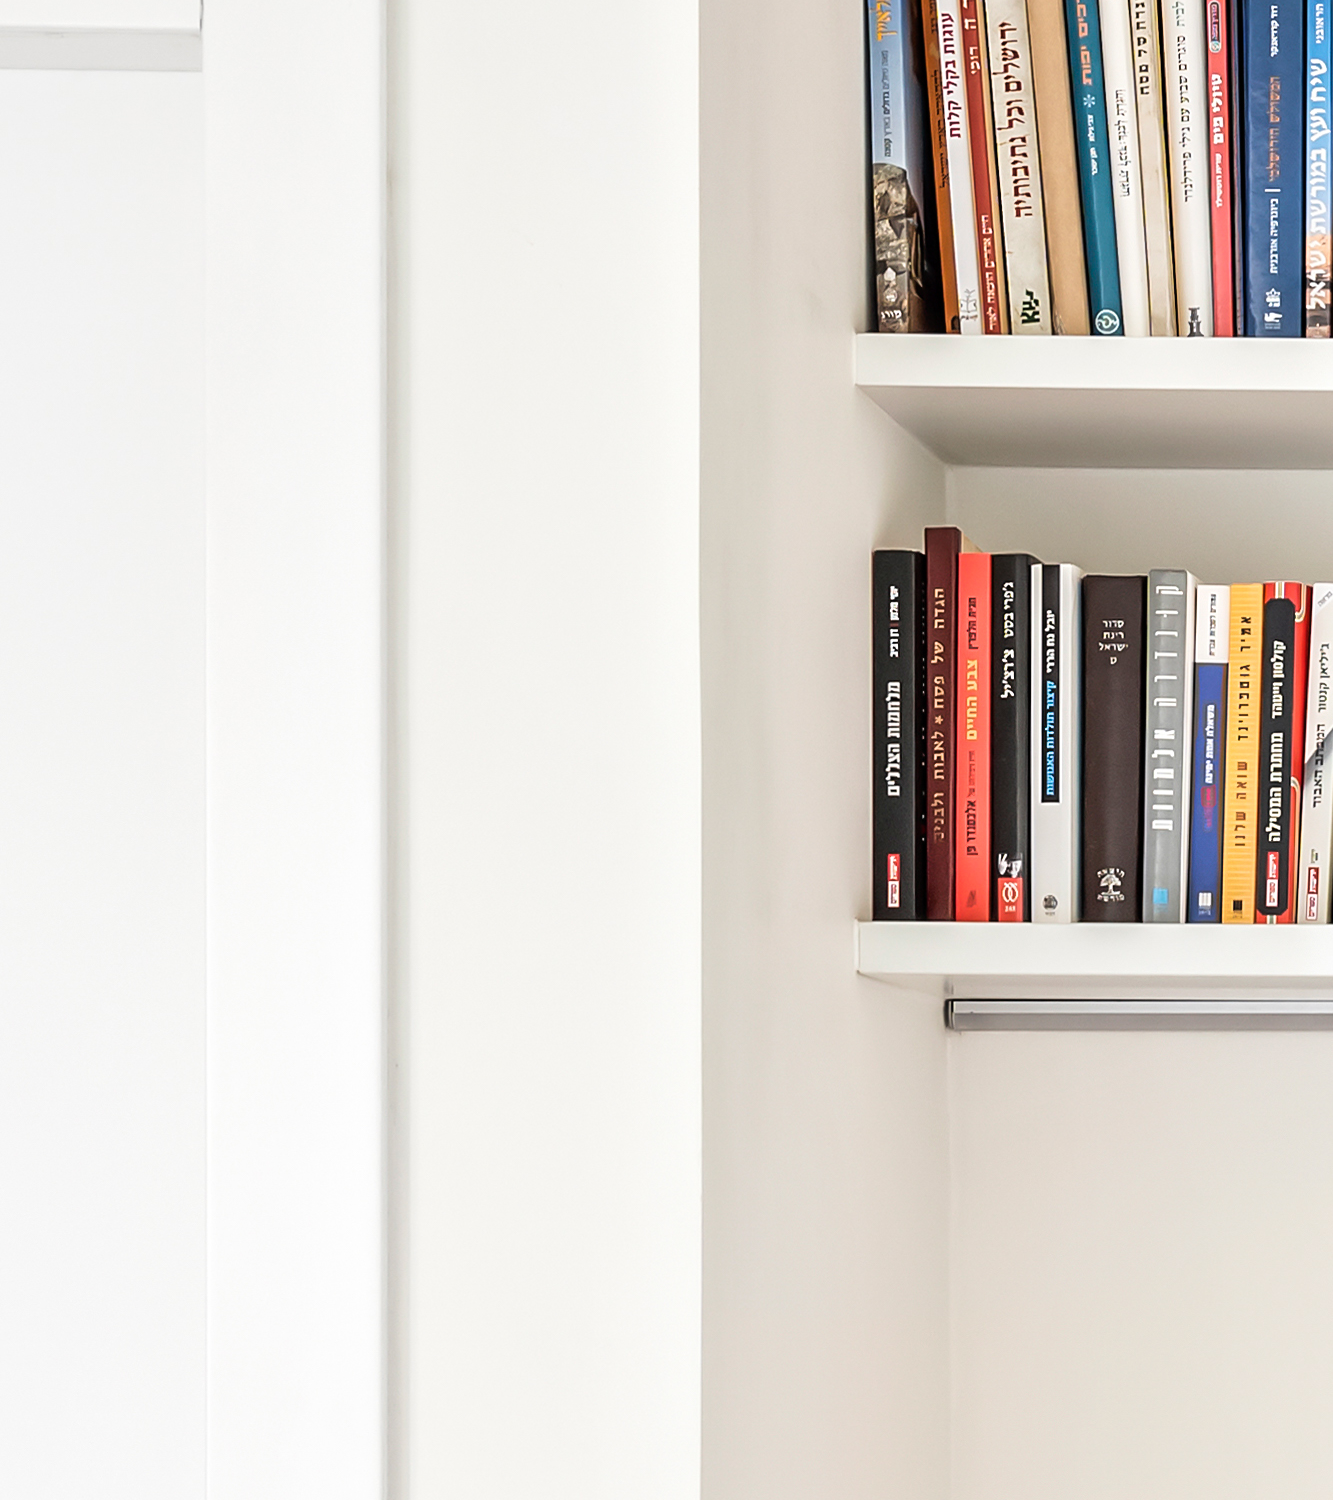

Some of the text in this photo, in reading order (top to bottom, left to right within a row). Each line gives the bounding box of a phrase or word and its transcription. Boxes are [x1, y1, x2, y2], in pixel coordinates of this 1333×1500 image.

[1137, 37, 1147, 57] של
[1081, 46, 1092, 85] יפות
[1140, 65, 1149, 94] פסח
[997, 21, 1032, 217] ירושלים וכל נתיבותיה
[1211, 74, 1225, 144] טיולי מים
[1045, 610, 1055, 631] יובל
[1102, 620, 1124, 628] סדור
[1047, 634, 1055, 646] נח
[1098, 642, 1128, 651] ישראל
[1047, 681, 1056, 709] קיצור
[886, 682, 900, 796] מלחמות הצללים
[1045, 712, 1054, 748] תולדות
[1235, 617, 1251, 846] אמיר גוטפרוינד שואה שלנו
[1313, 644, 1330, 807] ג'יליאן קנטור המכתב האבוד
